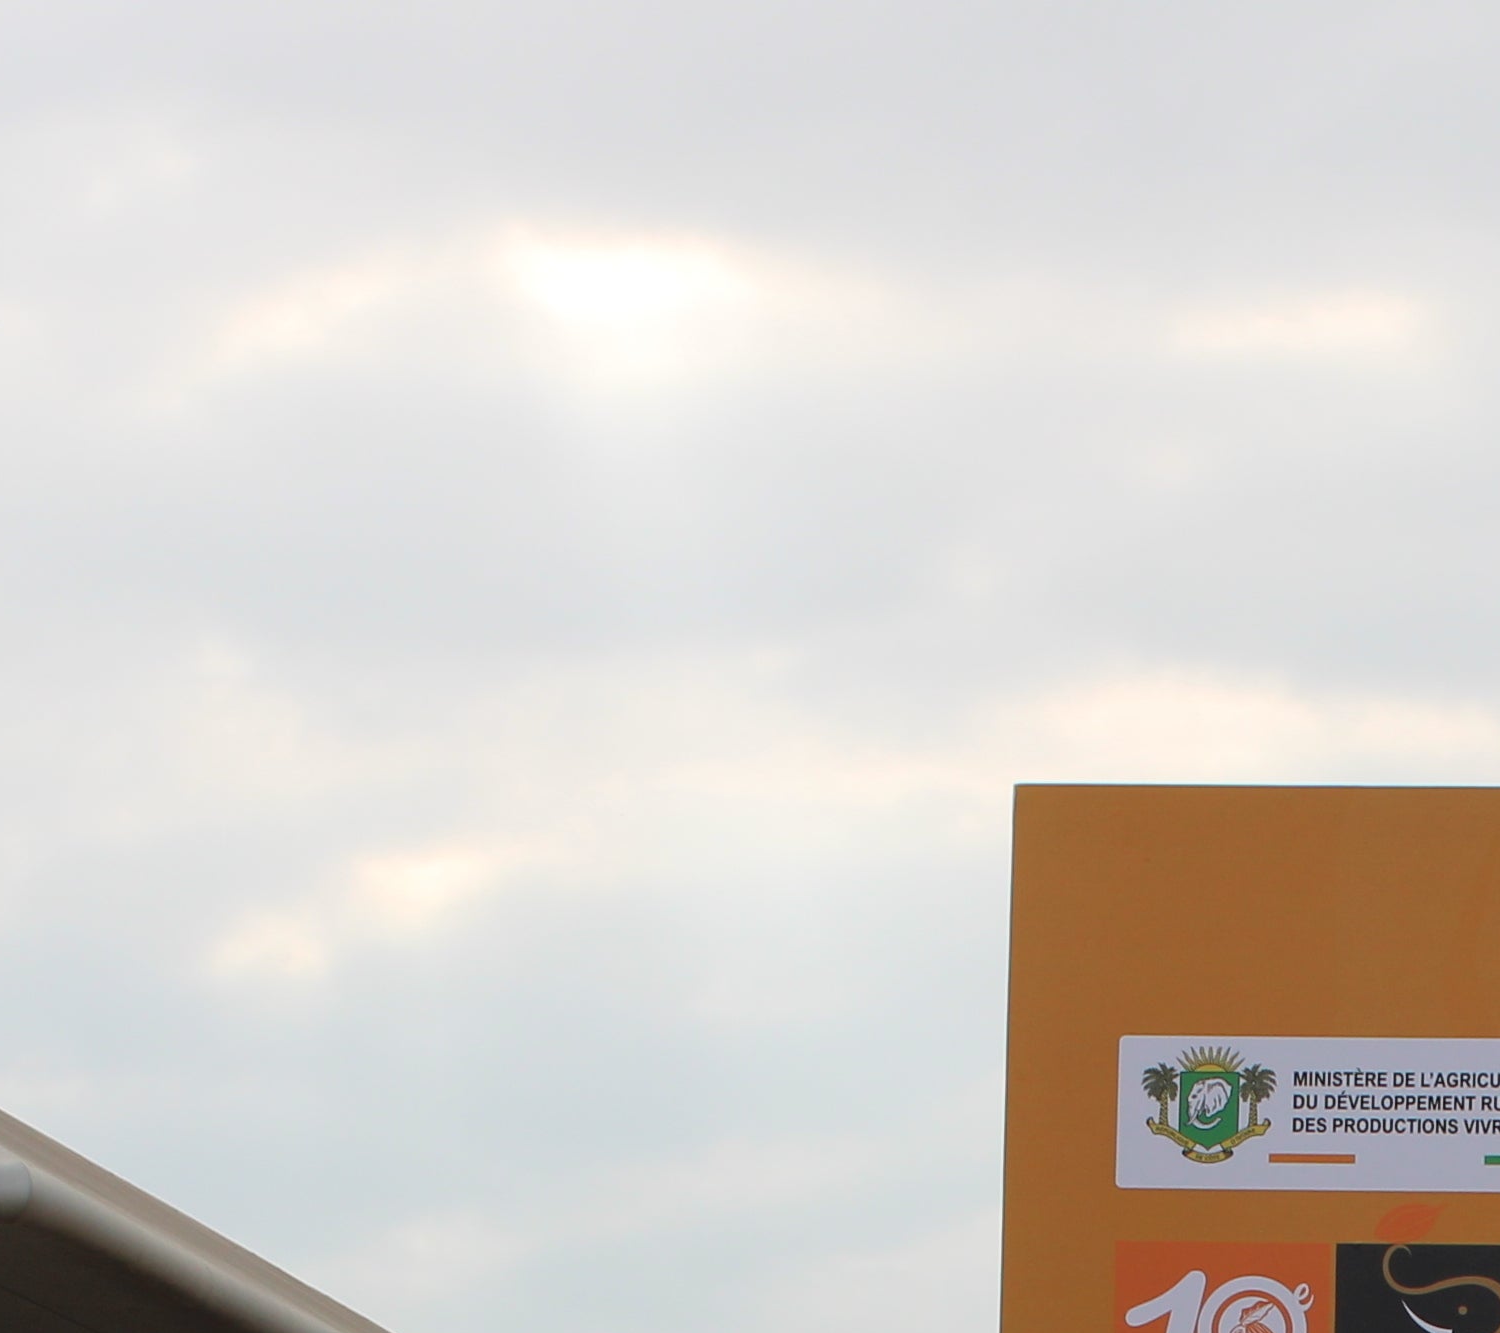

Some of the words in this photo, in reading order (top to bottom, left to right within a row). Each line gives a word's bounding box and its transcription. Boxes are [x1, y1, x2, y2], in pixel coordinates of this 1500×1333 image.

[1293, 1068, 1388, 1088] MINISTÈRE
[1392, 1072, 1416, 1088] DE
[1293, 1094, 1318, 1110] DU
[1324, 1091, 1476, 1111] DÉVELOPPEMENT
[1292, 1117, 1327, 1133] DES
[1332, 1117, 1458, 1135] PRODUCTIONS
